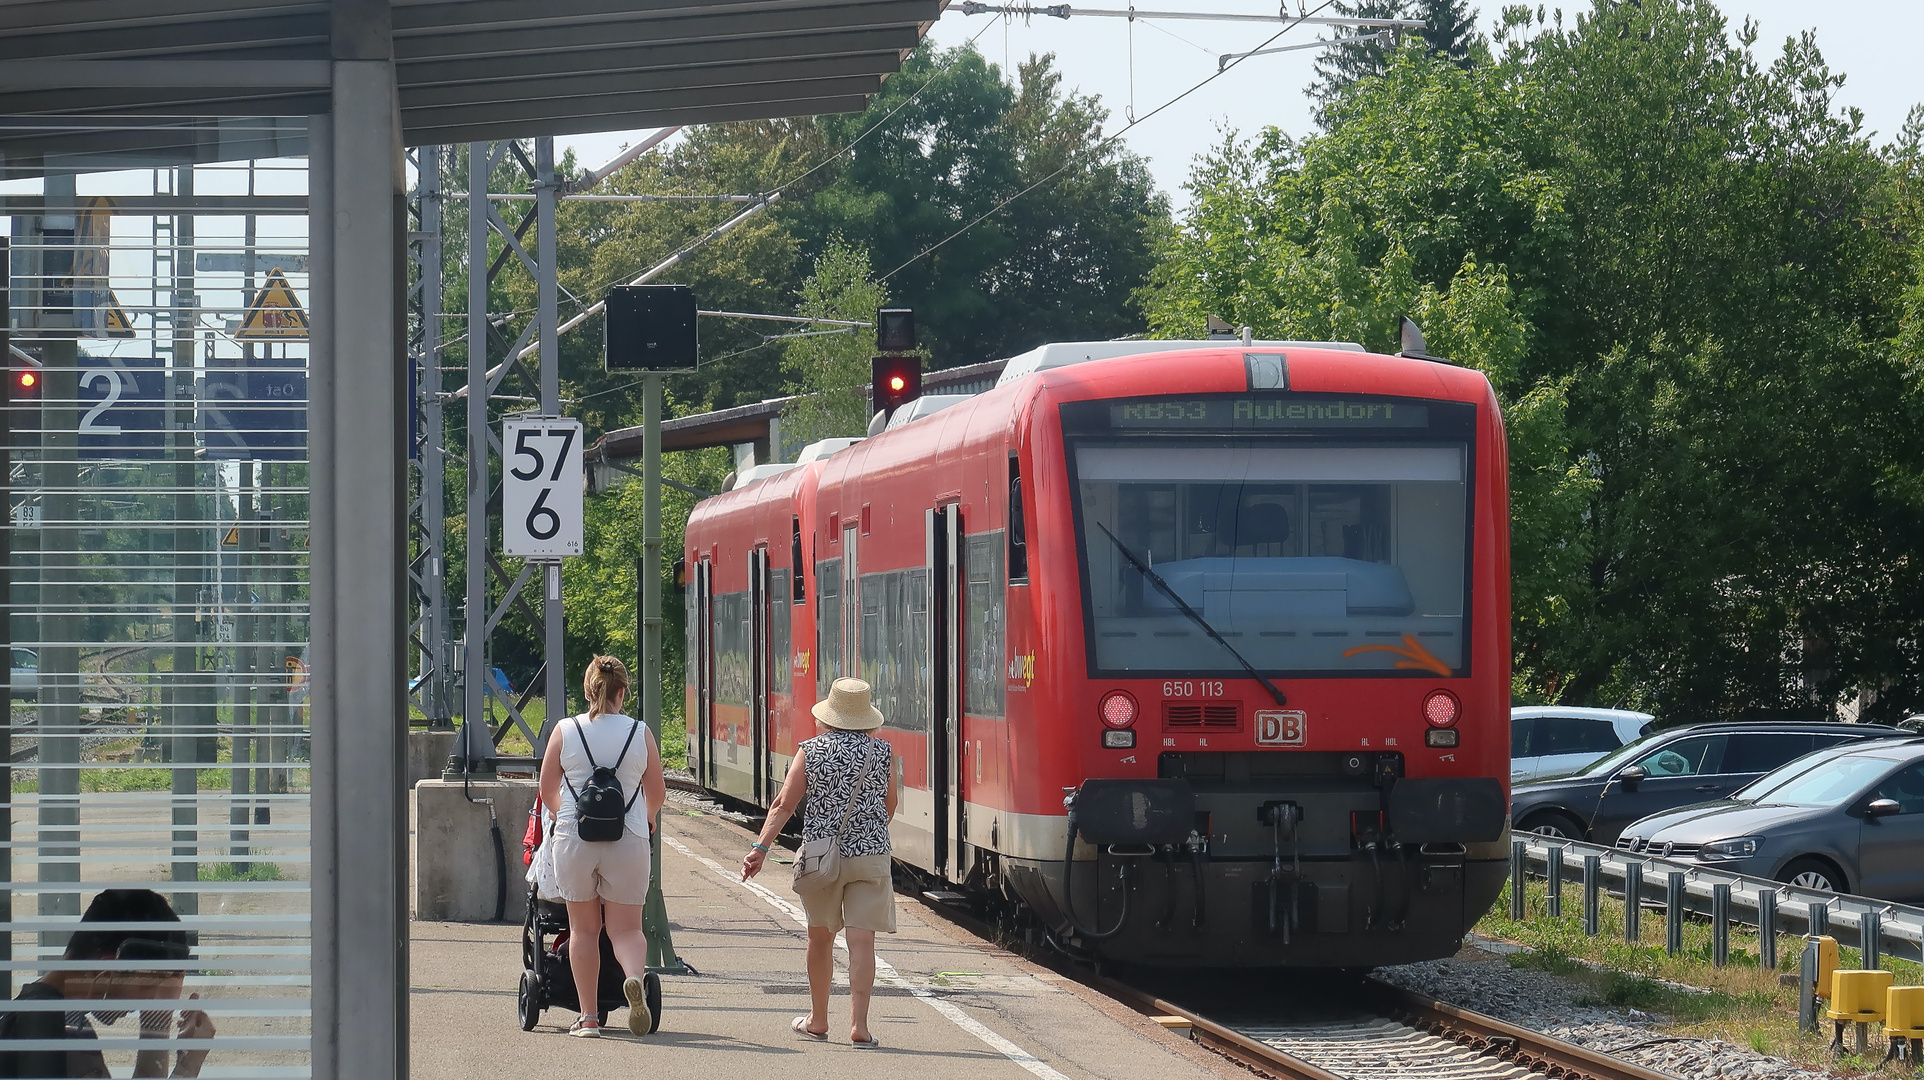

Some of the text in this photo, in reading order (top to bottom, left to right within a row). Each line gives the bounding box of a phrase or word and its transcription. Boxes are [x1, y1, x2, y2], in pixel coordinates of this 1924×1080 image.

[78, 370, 121, 435] 2
[510, 430, 576, 481] 57
[525, 488, 561, 540] 6
[1163, 681, 1224, 697] 650 113
[1199, 738, 1208, 747] HL
[1361, 737, 1370, 747] HL
[1262, 716, 1300, 741] DB
